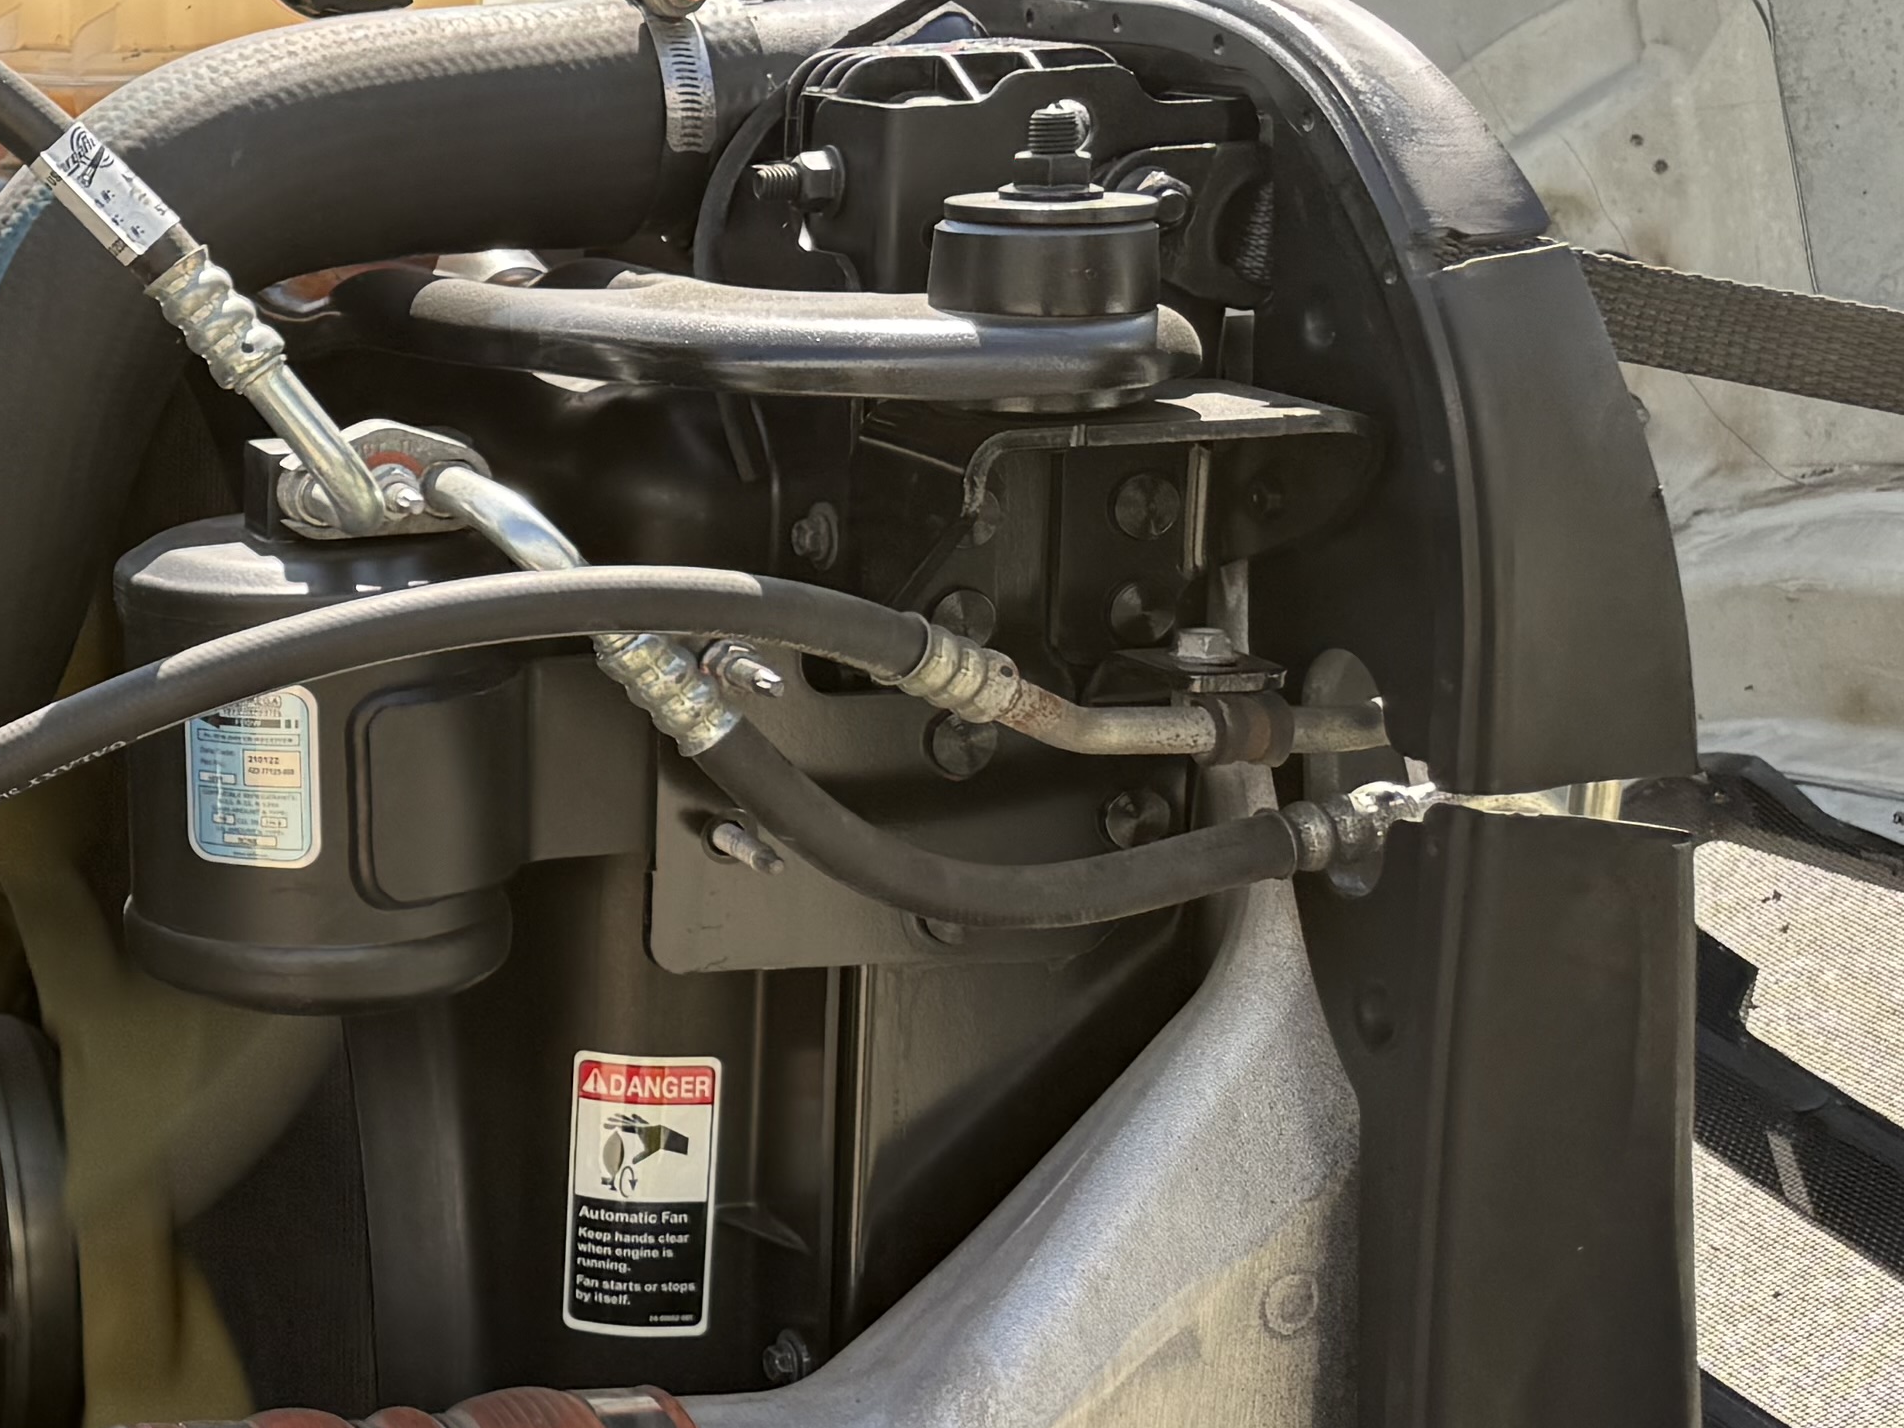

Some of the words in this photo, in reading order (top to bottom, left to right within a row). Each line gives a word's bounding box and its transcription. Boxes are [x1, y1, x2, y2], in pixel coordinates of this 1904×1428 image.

[609, 1074, 711, 1099] DANGER
[579, 1205, 657, 1224] Automatic
[661, 1211, 688, 1224] Fan
[578, 1227, 611, 1242] Keep
[614, 1231, 655, 1244] hands
[658, 1233, 689, 1244] clear
[577, 1242, 611, 1256] when
[615, 1246, 659, 1260] engine
[662, 1247, 673, 1258] is
[577, 1257, 631, 1273] running.
[576, 1274, 599, 1287] Fan
[602, 1280, 641, 1291] starts
[644, 1283, 657, 1292] or
[661, 1282, 696, 1294] stops
[575, 1288, 591, 1302] by
[594, 1291, 631, 1305] itself.
